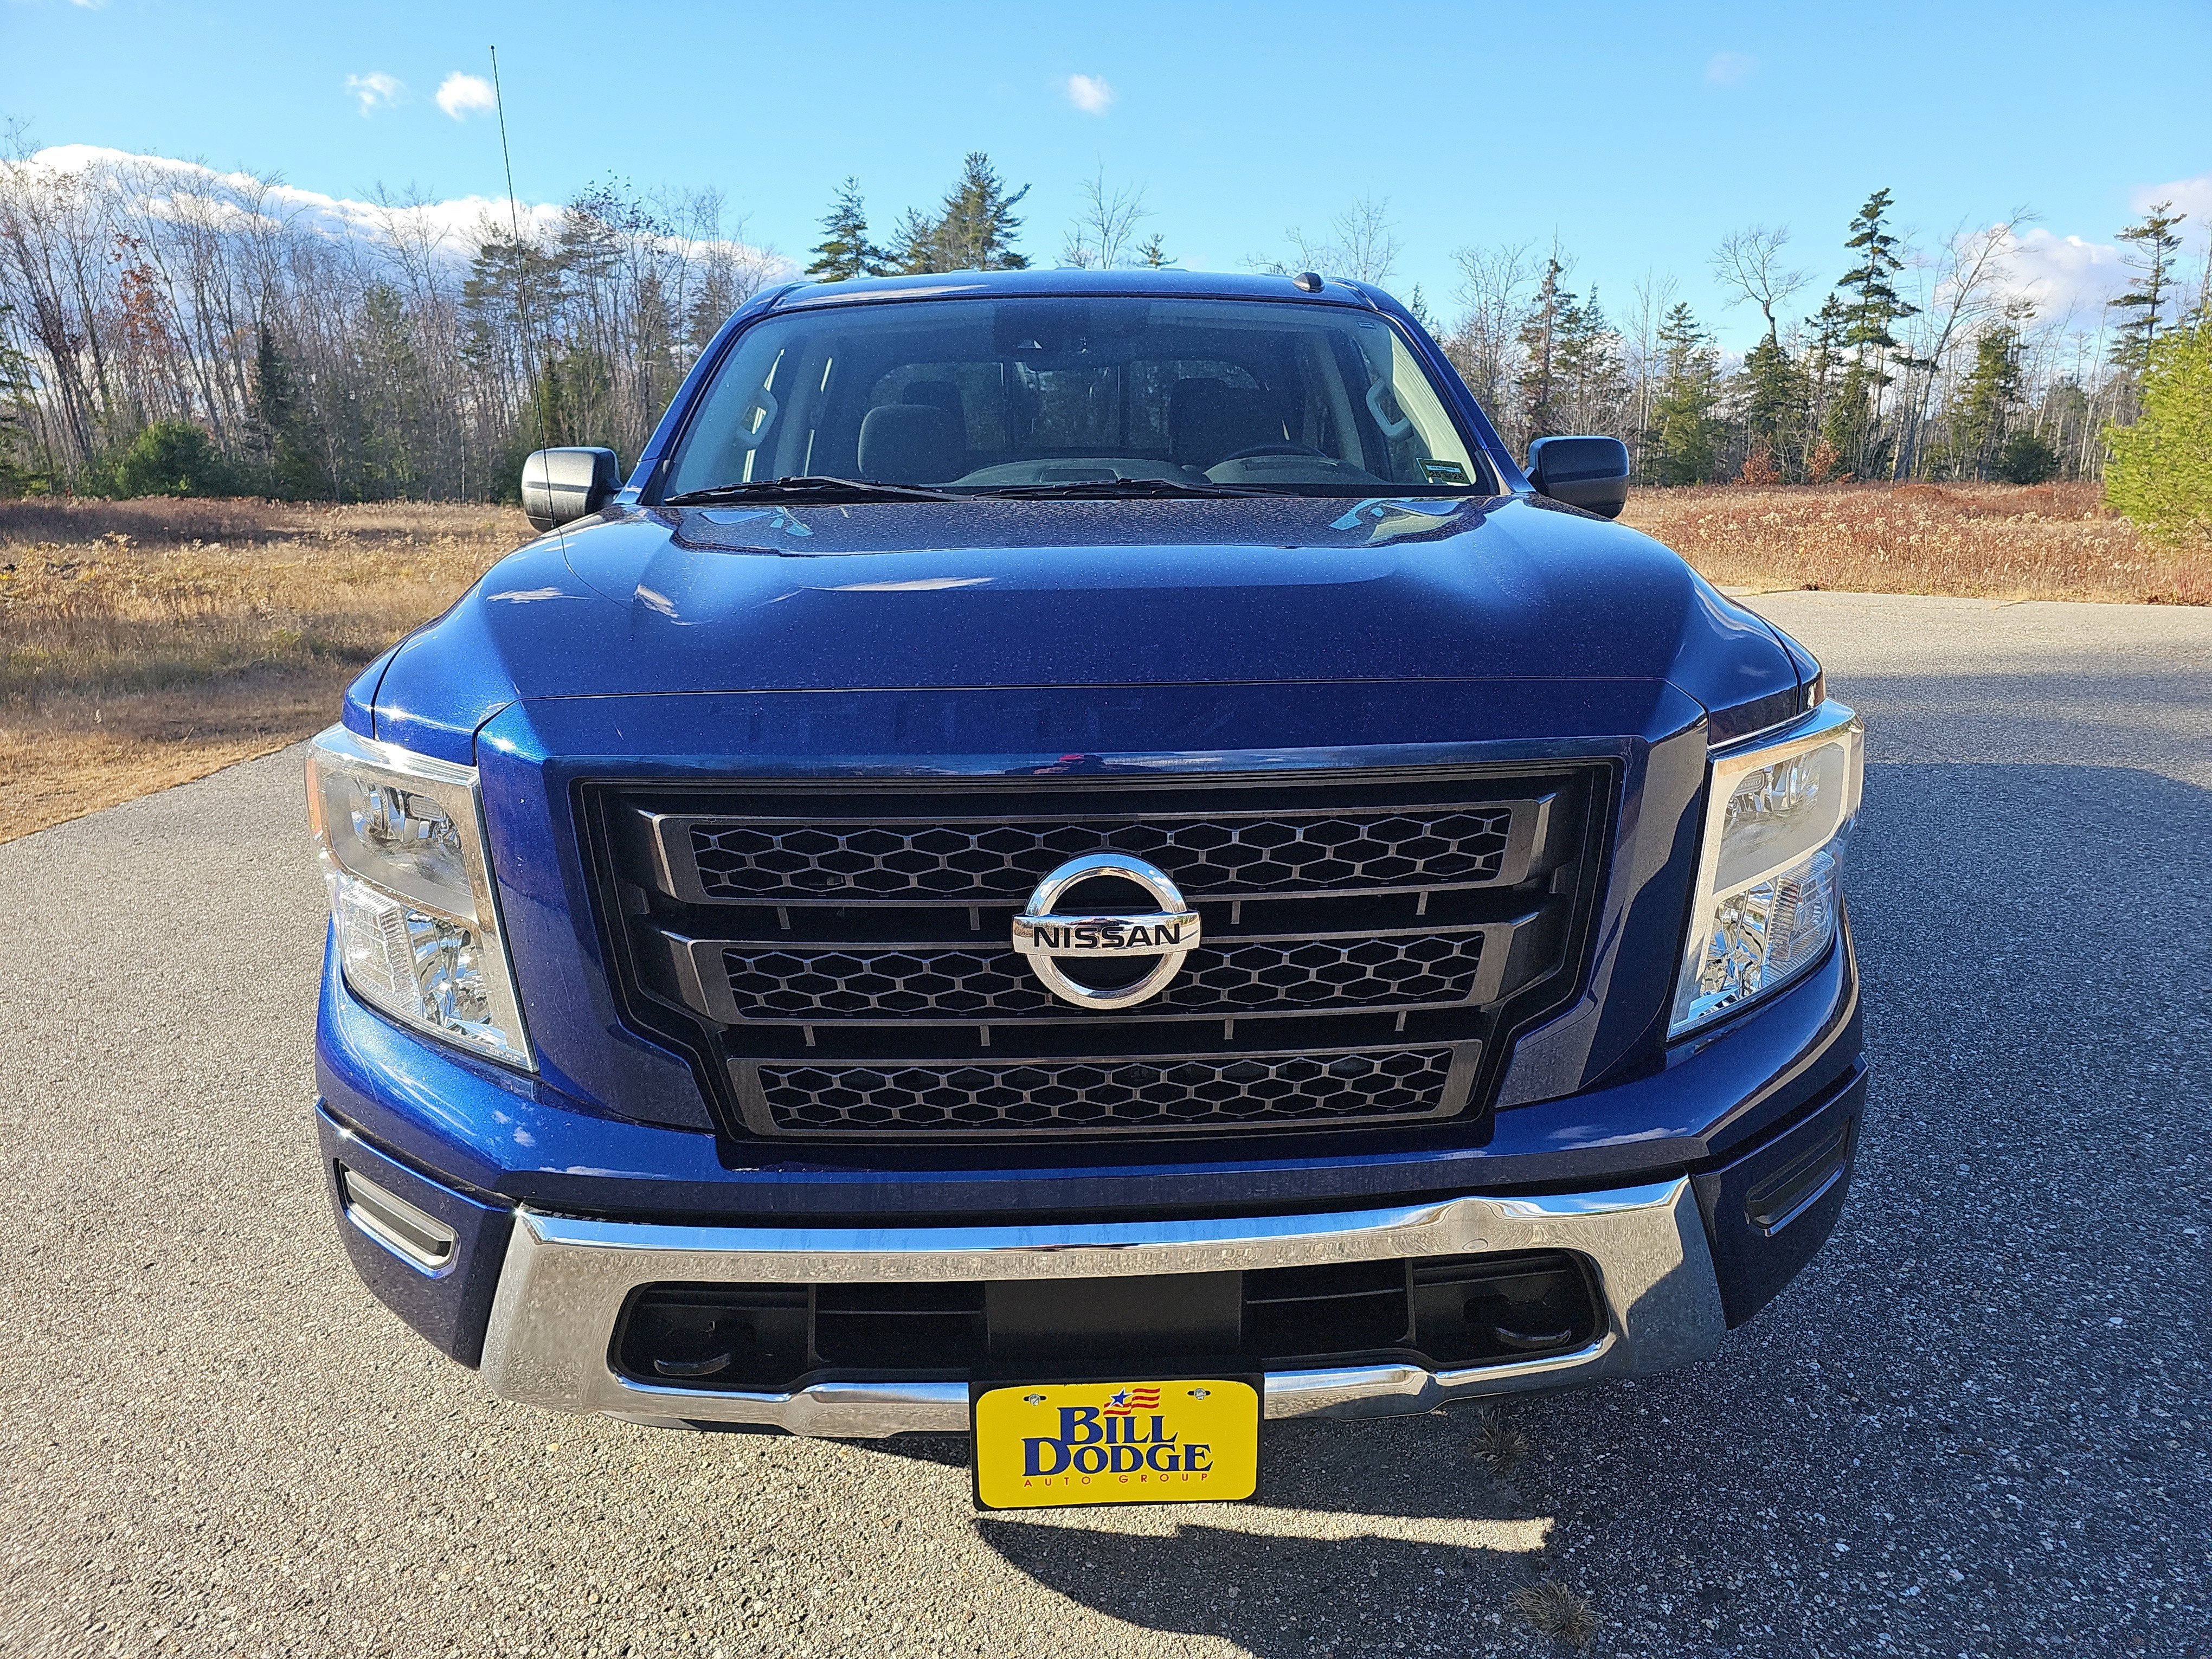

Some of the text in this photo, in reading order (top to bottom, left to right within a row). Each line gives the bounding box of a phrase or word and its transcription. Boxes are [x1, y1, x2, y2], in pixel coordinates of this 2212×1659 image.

[1033, 923, 1181, 948] NISSAN
[1056, 1406, 1178, 1445] BILL
[1021, 1437, 1214, 1477] DODGE
[1023, 1472, 1208, 1488] AUTO GROUP
